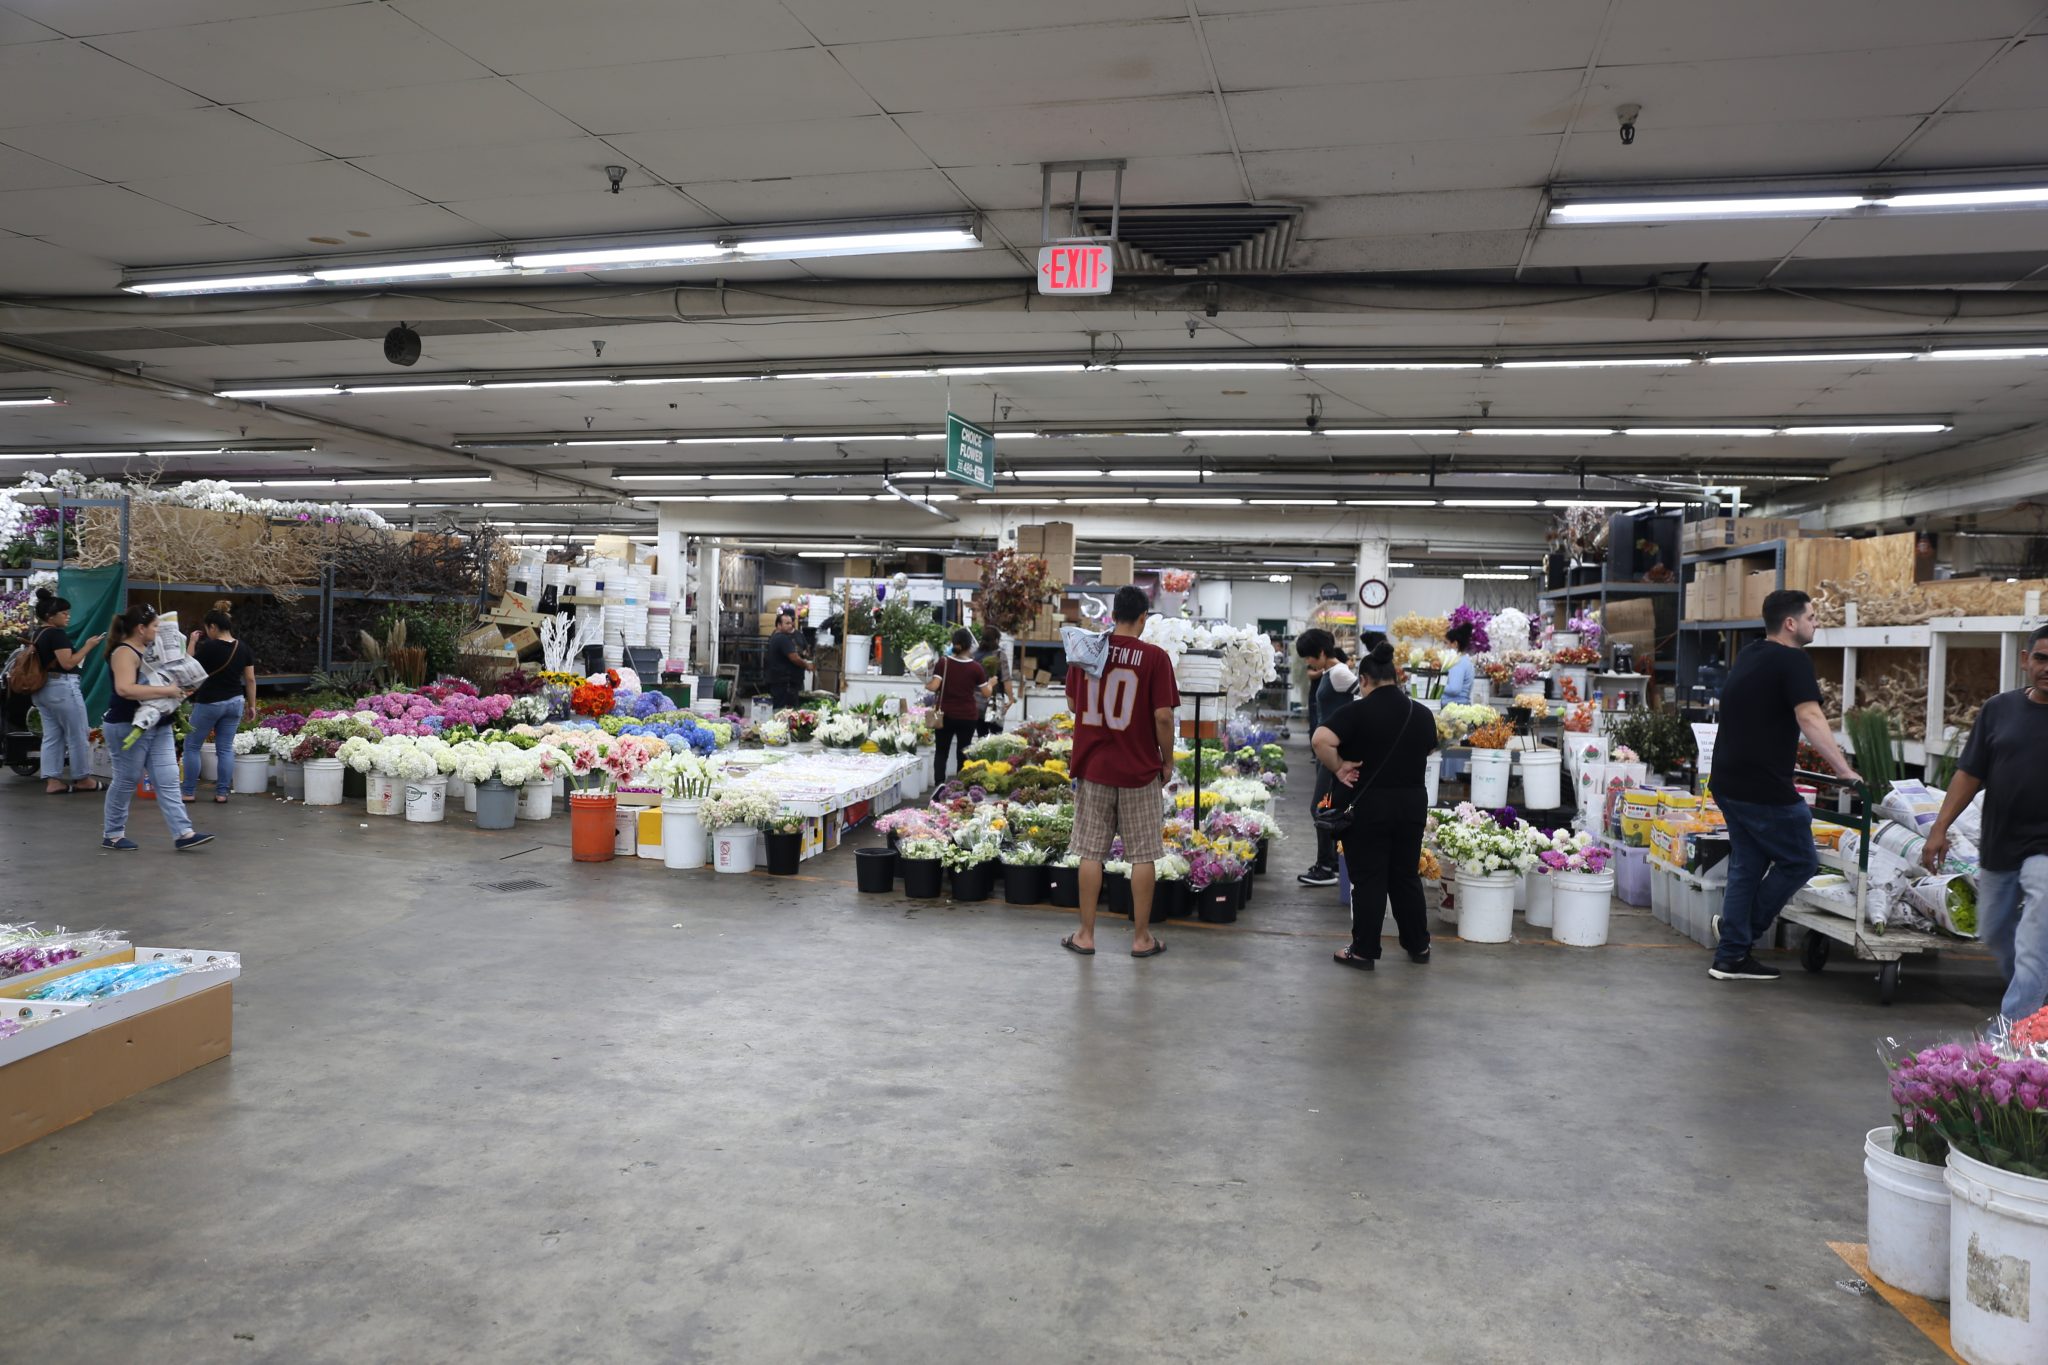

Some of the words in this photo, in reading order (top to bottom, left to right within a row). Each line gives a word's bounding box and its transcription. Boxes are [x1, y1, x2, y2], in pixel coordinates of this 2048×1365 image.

[1051, 248, 1103, 289] EXIT
[961, 427, 983, 448] CHOICE
[960, 443, 983, 464] FLOWER
[1131, 649, 1143, 666] III
[1082, 667, 1139, 732] 10
